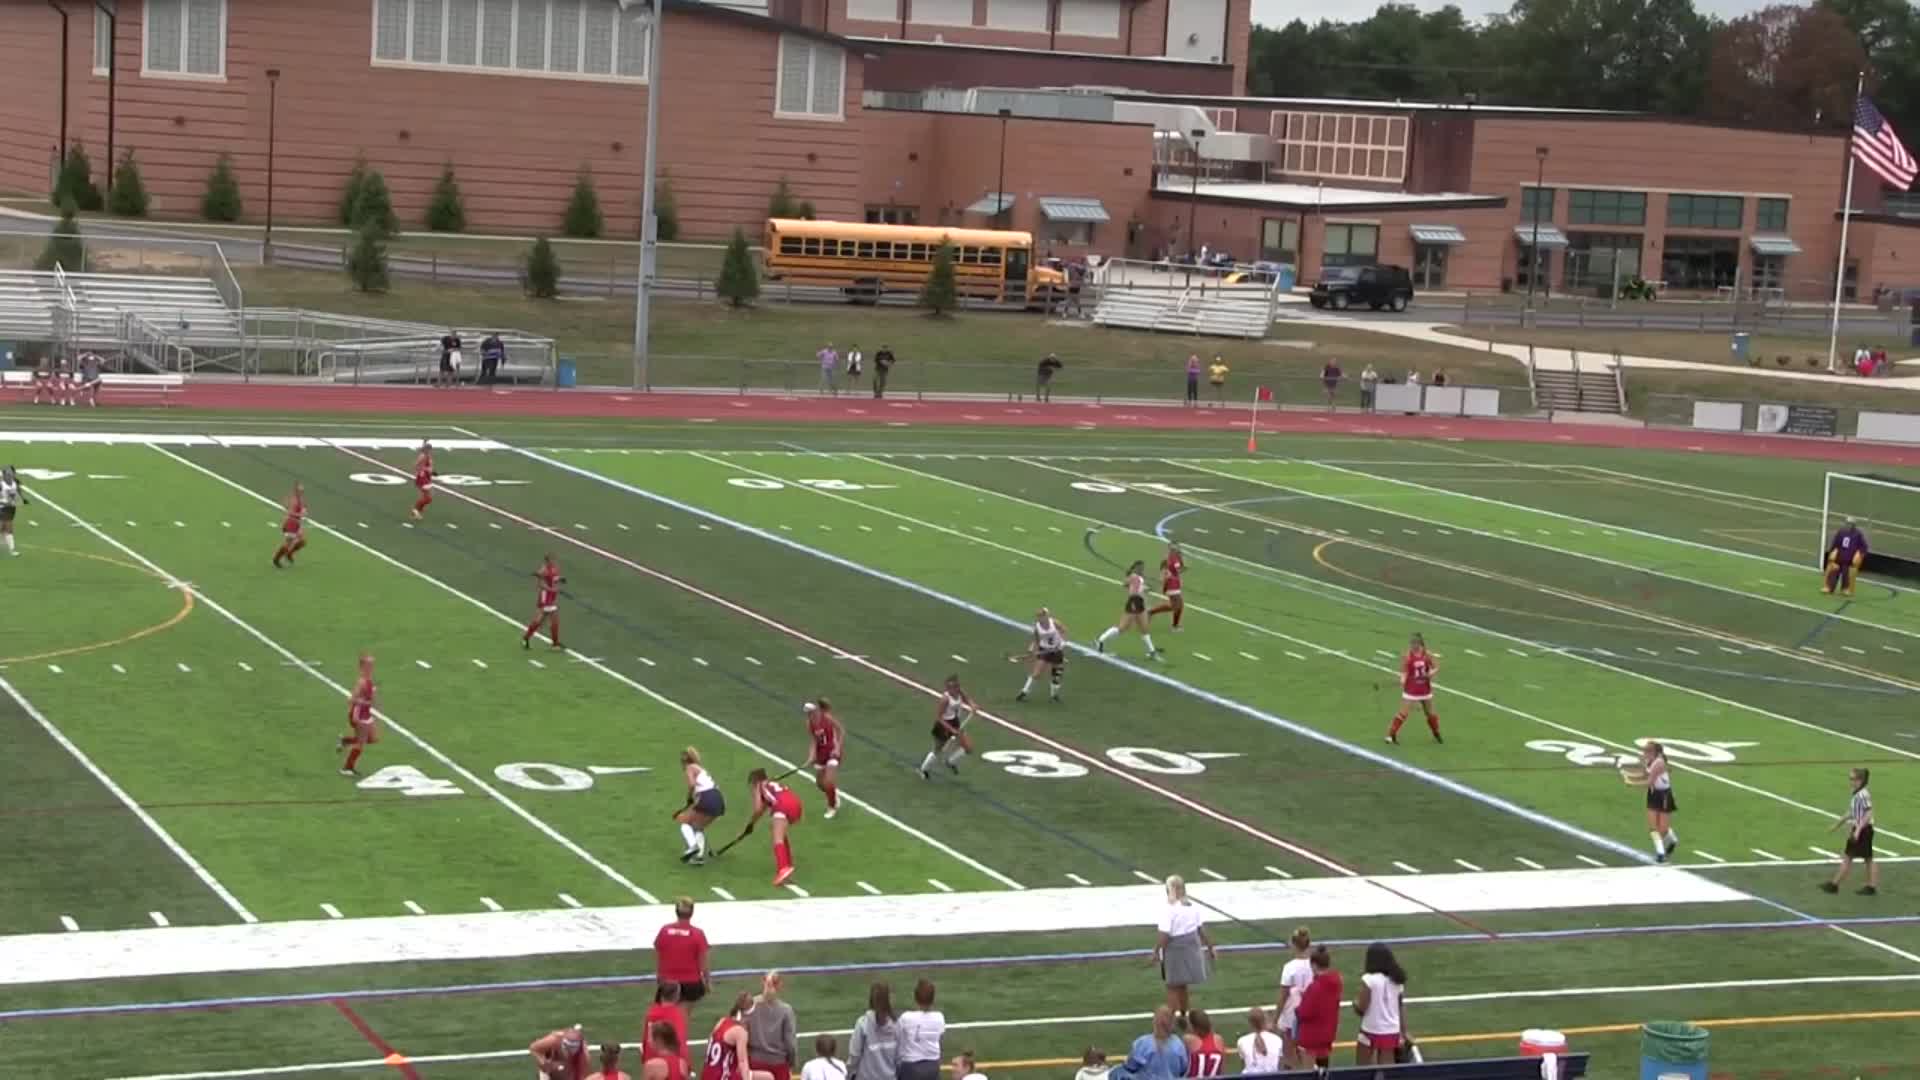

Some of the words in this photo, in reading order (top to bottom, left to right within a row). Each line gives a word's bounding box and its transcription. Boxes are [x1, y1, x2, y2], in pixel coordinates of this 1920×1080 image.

[981, 747, 1206, 777] 30
[1525, 738, 1736, 766] 20
[356, 764, 593, 796] 40
[1198, 1053, 1221, 1078] 17
